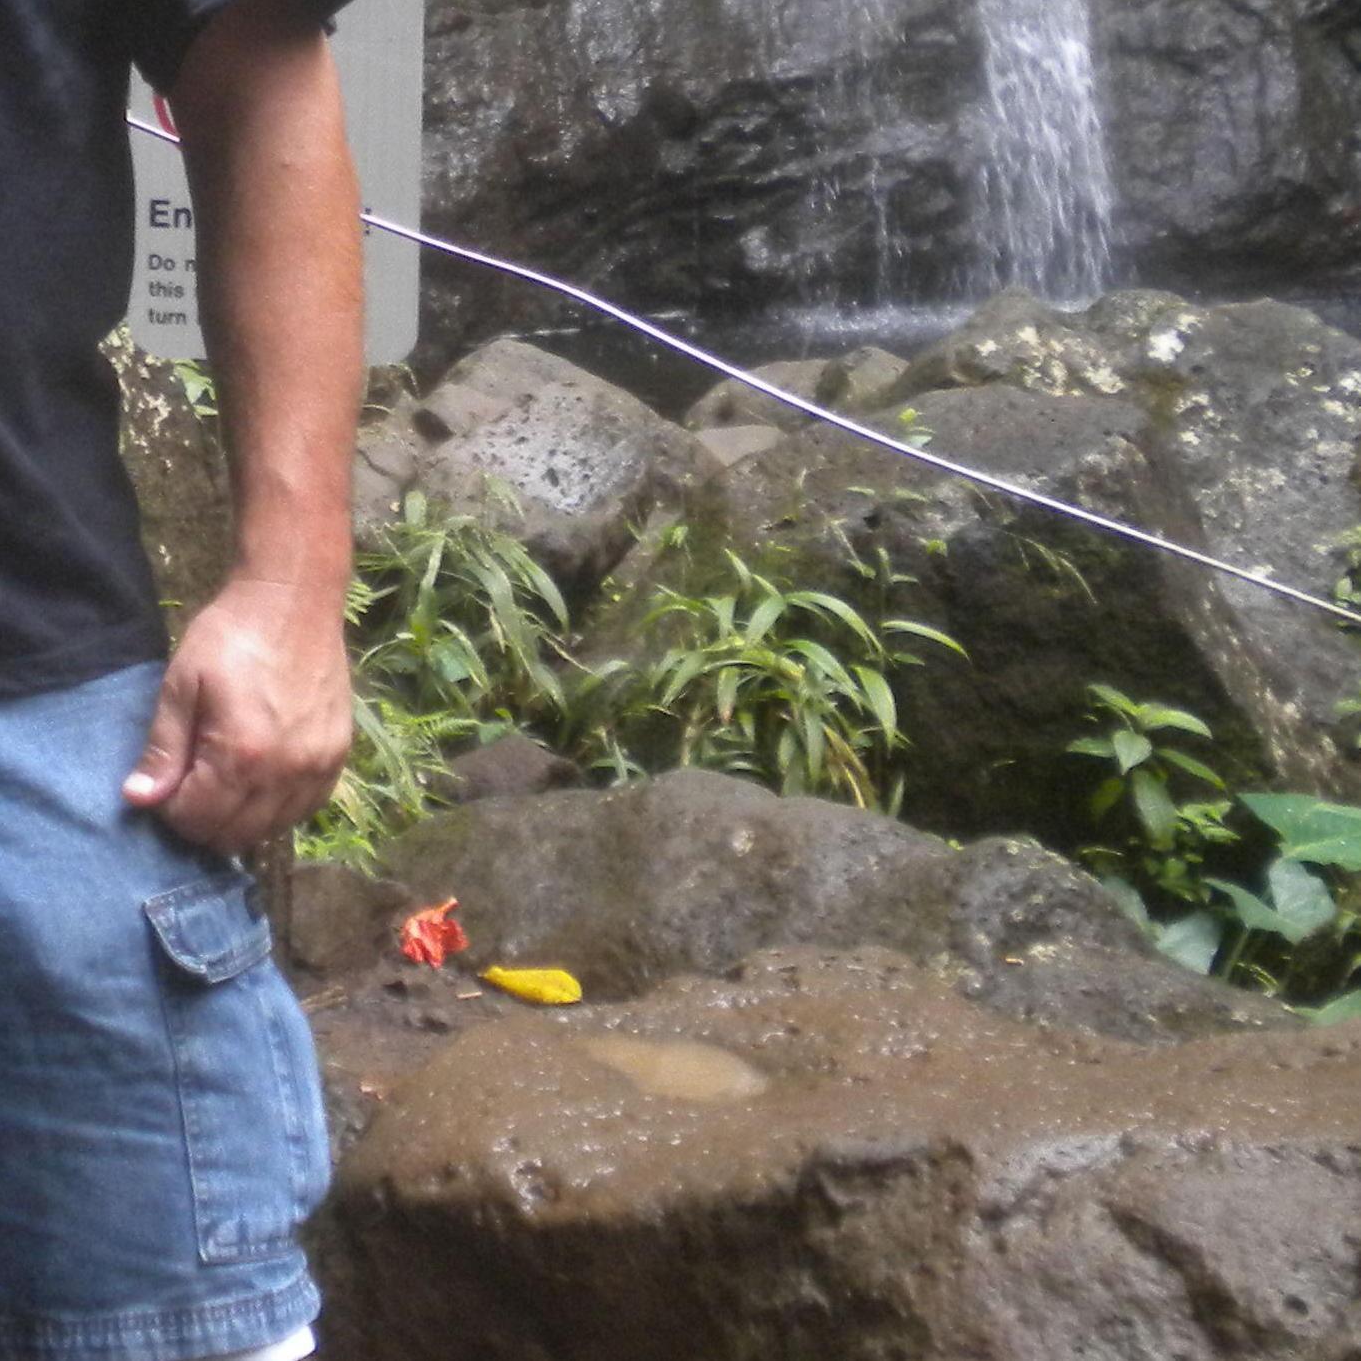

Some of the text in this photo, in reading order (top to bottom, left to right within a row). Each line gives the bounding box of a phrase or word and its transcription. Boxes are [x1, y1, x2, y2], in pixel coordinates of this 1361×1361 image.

[149, 198, 192, 228] En
[148, 254, 176, 271] Do
[148, 280, 185, 298] this
[148, 308, 187, 326] turn
